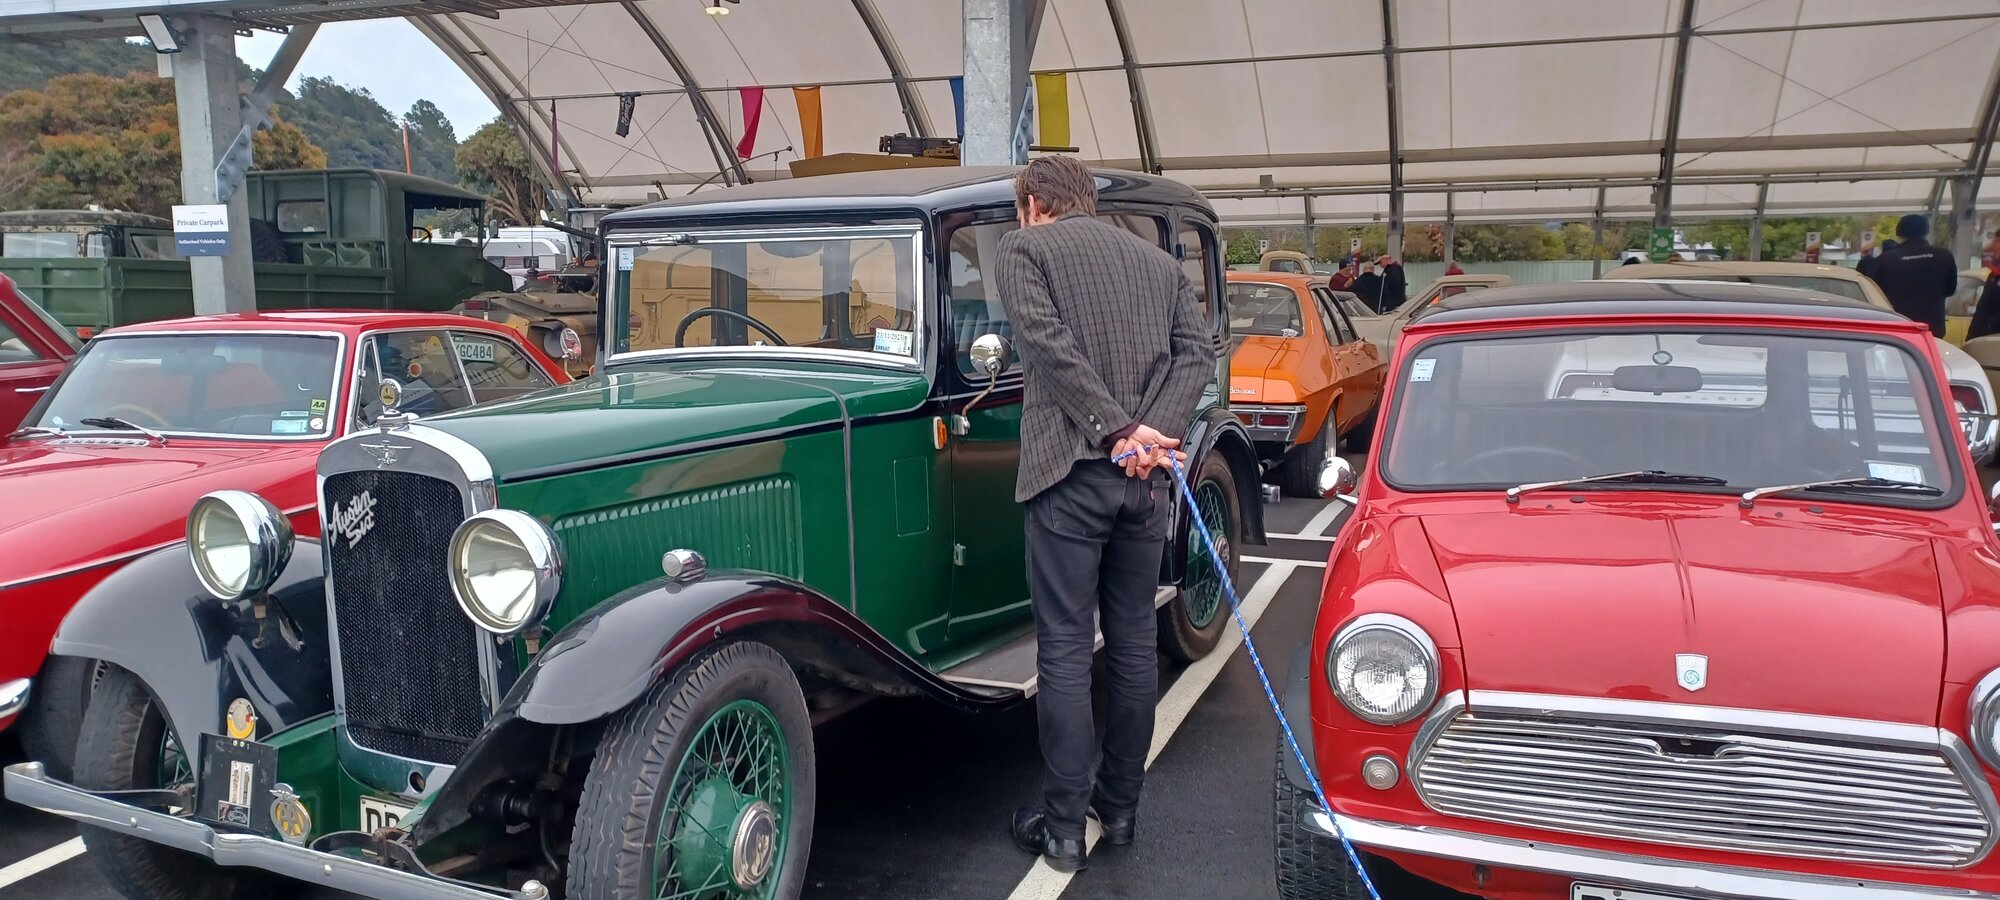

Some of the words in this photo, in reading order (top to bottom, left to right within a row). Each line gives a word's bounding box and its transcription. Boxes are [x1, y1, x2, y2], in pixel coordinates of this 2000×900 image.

[199, 218, 224, 227] Carpark
[312, 401, 325, 409] AA
[328, 490, 378, 548] Austin
[346, 508, 375, 549] Six
